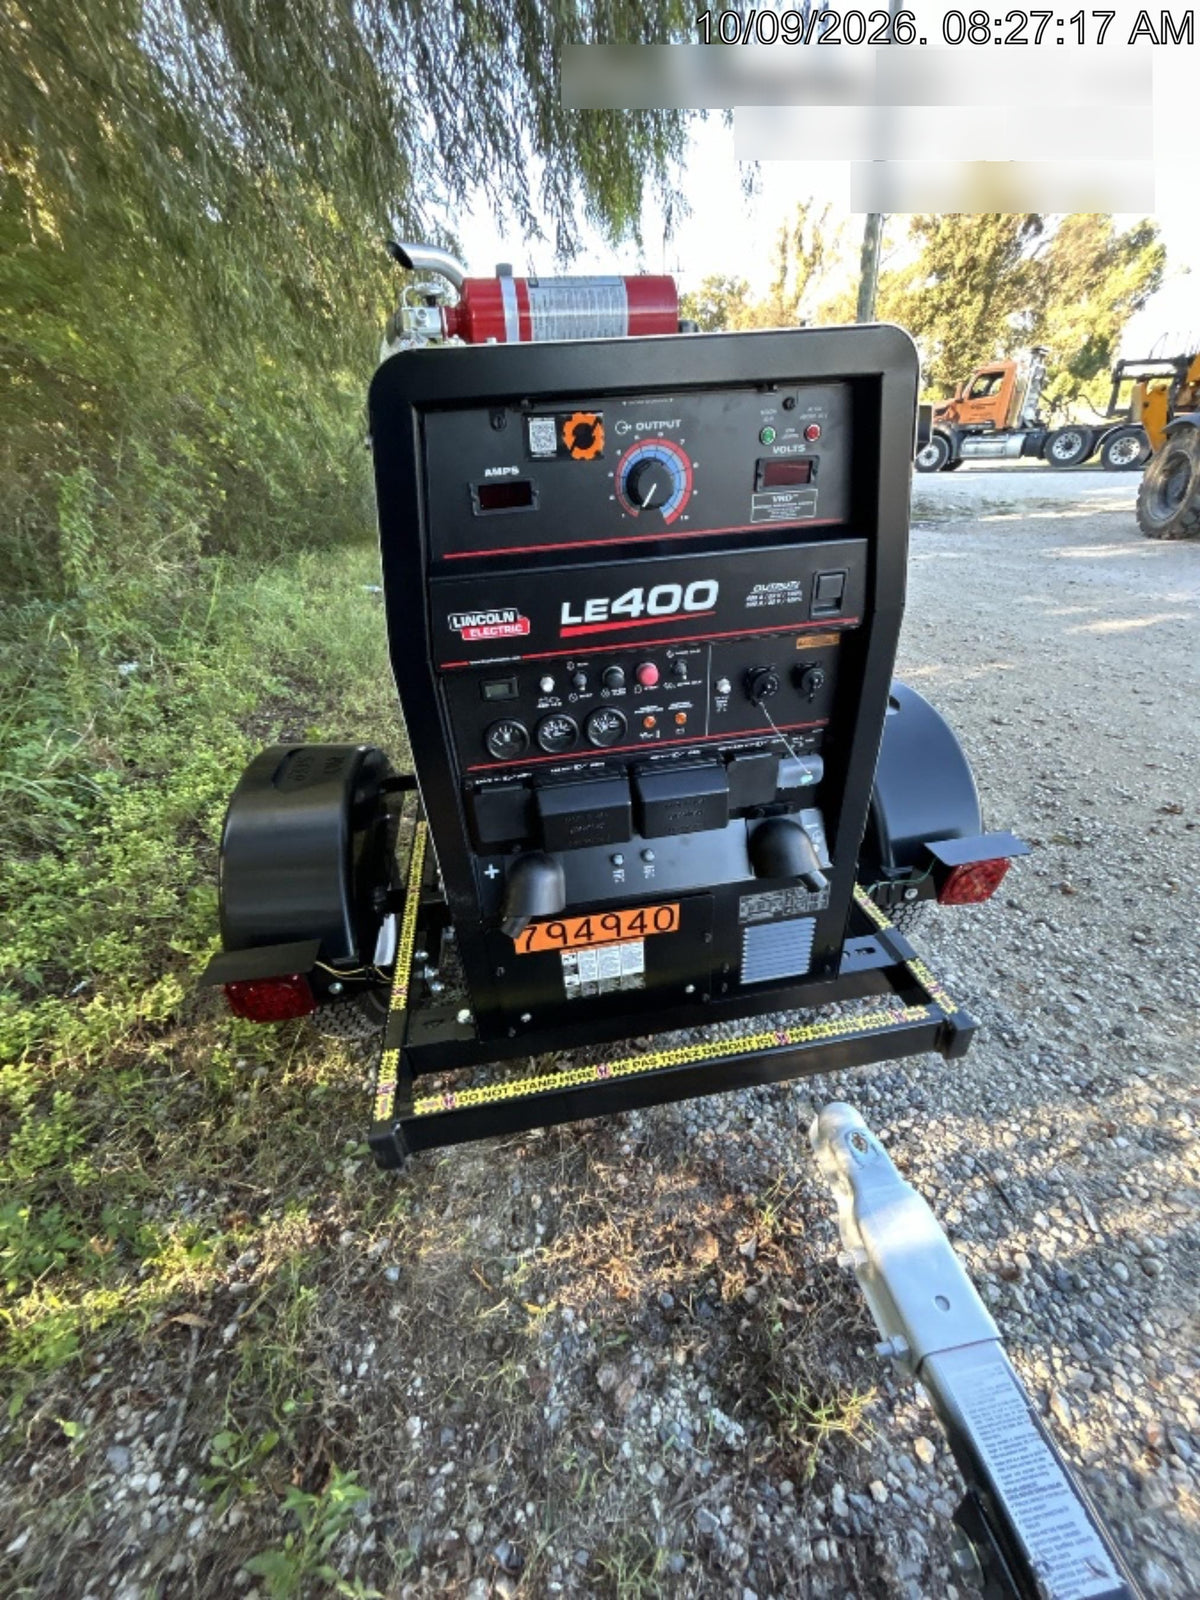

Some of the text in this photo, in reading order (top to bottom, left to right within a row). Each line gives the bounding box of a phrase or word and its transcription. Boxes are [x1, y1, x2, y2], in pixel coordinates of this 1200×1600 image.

[635, 419, 682, 431] OUTPUT
[772, 444, 806, 455] VOLTS
[484, 466, 520, 477] AMPS
[561, 579, 720, 625] LE400
[452, 611, 515, 629] LINCOLN
[470, 623, 524, 637] ELECTRIC
[524, 905, 675, 952] 794940
[633, 1056, 658, 1067] PAS
[460, 1070, 595, 1103] DO NOT STAND HERE
